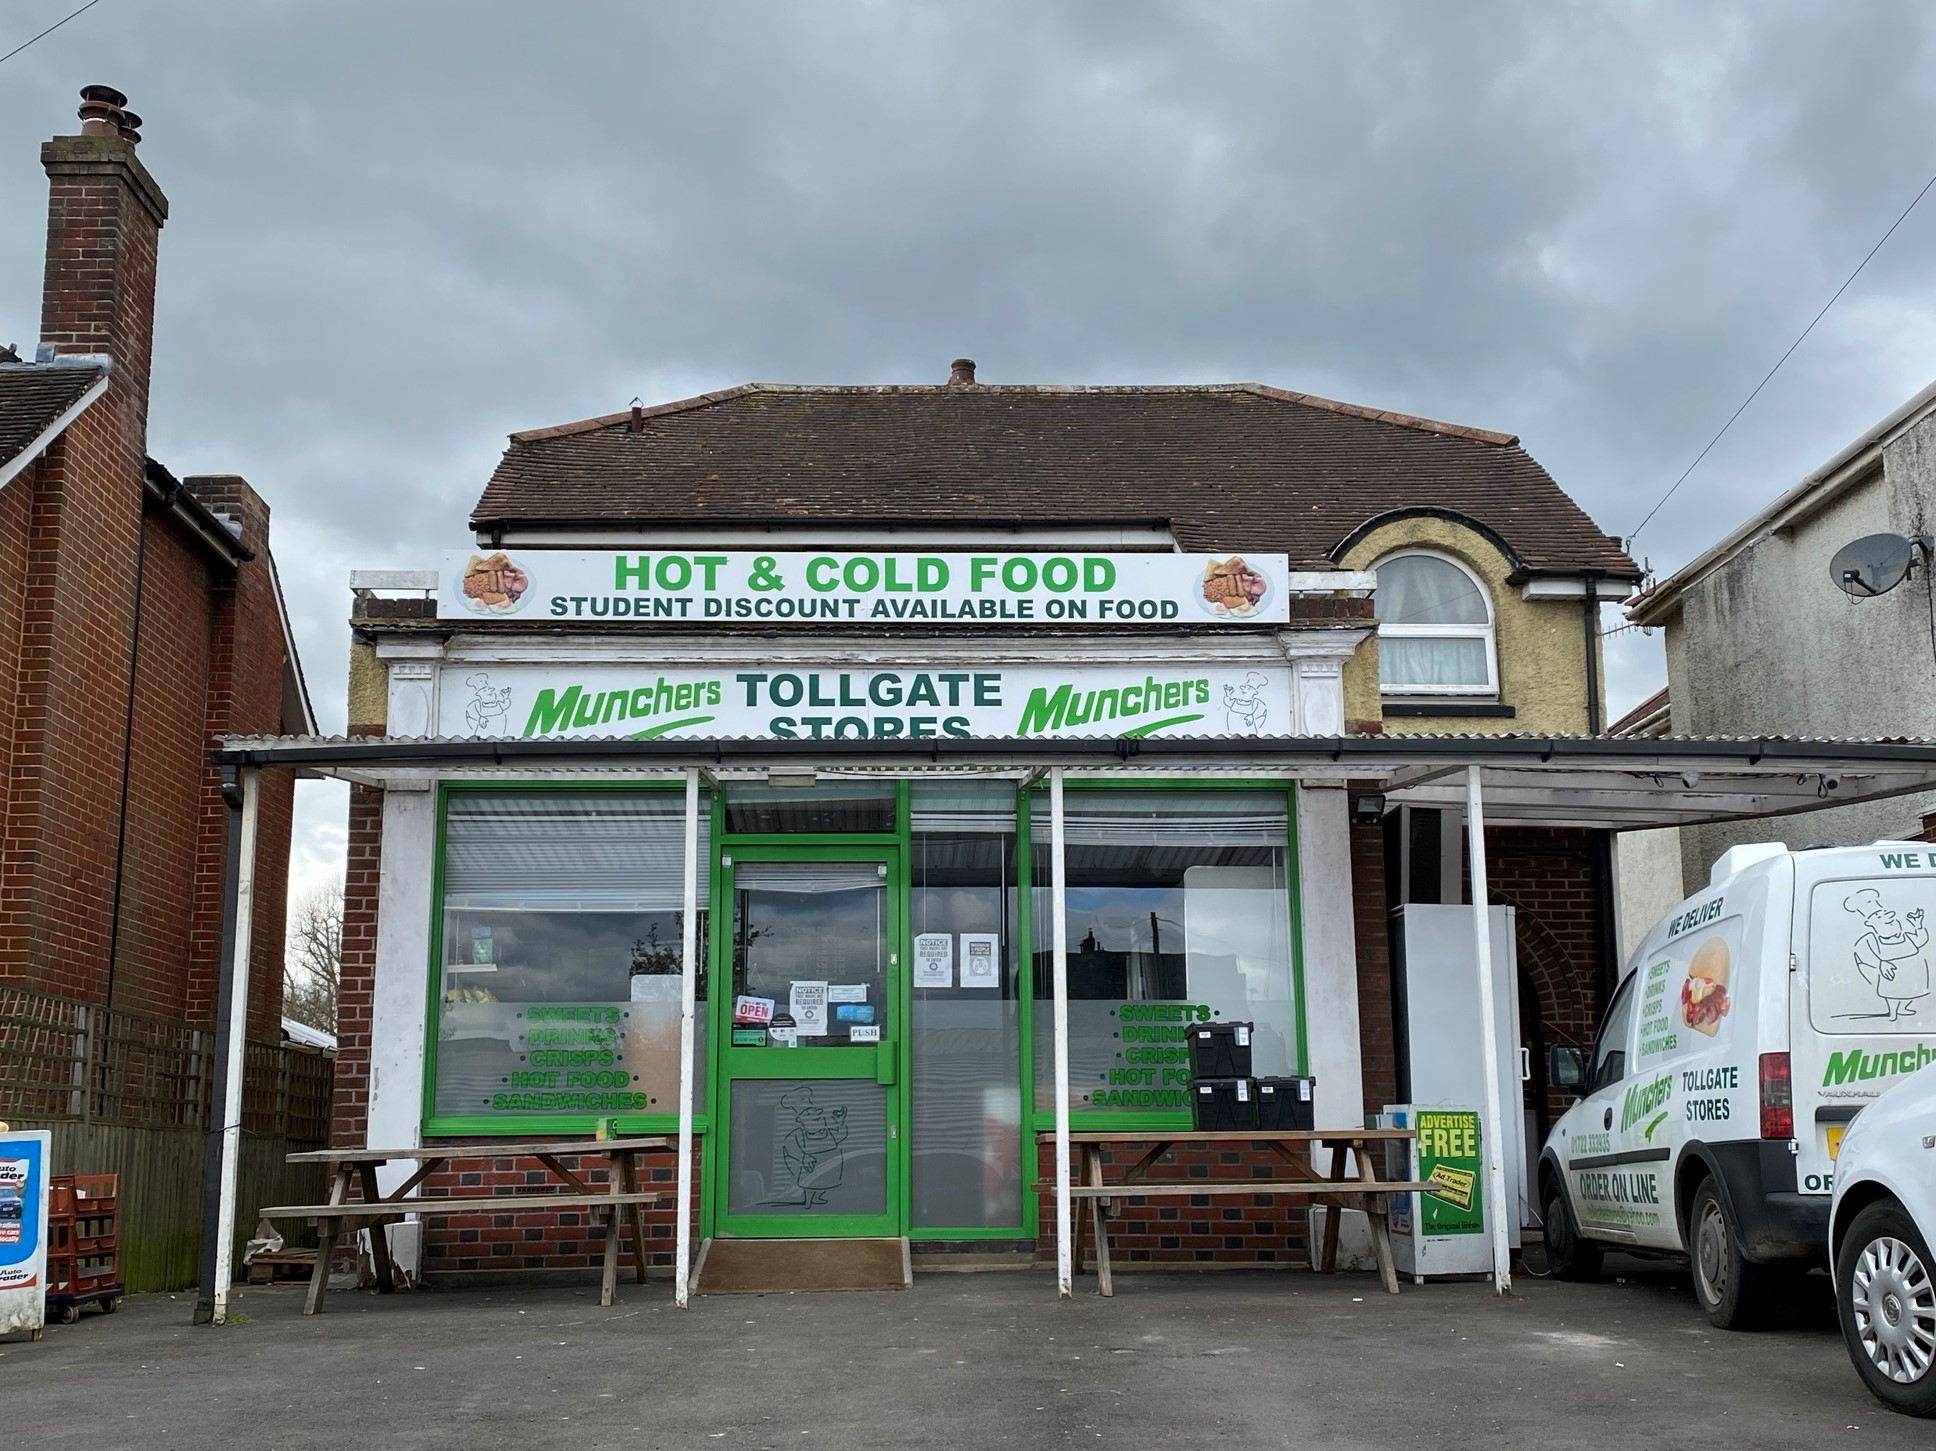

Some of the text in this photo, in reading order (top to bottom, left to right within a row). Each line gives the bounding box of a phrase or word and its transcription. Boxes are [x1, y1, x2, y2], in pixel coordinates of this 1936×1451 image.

[615, 555, 1117, 593] HOT & COLD FOOD
[550, 596, 1180, 620] STUDENT DISCOUNT AVAILABLE ON FOOD
[736, 673, 1003, 707] TOLLGATE
[522, 677, 721, 738] Munchers
[1016, 675, 1210, 737] Munchers
[769, 716, 971, 740] STORES
[1879, 853, 1921, 869] WE
[1668, 897, 1724, 938] WE DELIVER
[1650, 959, 1671, 980] SWEETS
[1647, 979, 1666, 998] DRINKS
[526, 1007, 620, 1024] SWEETS
[740, 1004, 769, 1018] OPEN
[1119, 1004, 1211, 1021] SWEETS
[1644, 999, 1663, 1018] CRISPS
[528, 1028, 617, 1045] DRINKS
[852, 1029, 877, 1037] PUSH
[1642, 1017, 1669, 1038] HOT FOOD
[1641, 1034, 1677, 1057] SANDWICHES
[530, 1050, 614, 1067] CRISPS
[1822, 1043, 1936, 1087] Munch
[511, 1071, 630, 1088] HOT FOOD
[1109, 1069, 1156, 1085] HOT
[1682, 1066, 1738, 1092] TOLLGATE
[492, 1092, 648, 1110] SANDWICHES
[1621, 1074, 1672, 1134] Munchers
[1686, 1097, 1730, 1121] STORES
[1420, 1115, 1475, 1128] ADVERTISE
[1421, 1129, 1476, 1158] FREE
[1571, 1135, 1586, 1154] 01722
[1436, 1172, 1446, 1180] Ad
[1447, 1175, 1468, 1187] Trader
[1580, 1173, 1660, 1204] ORDER ON LINE
